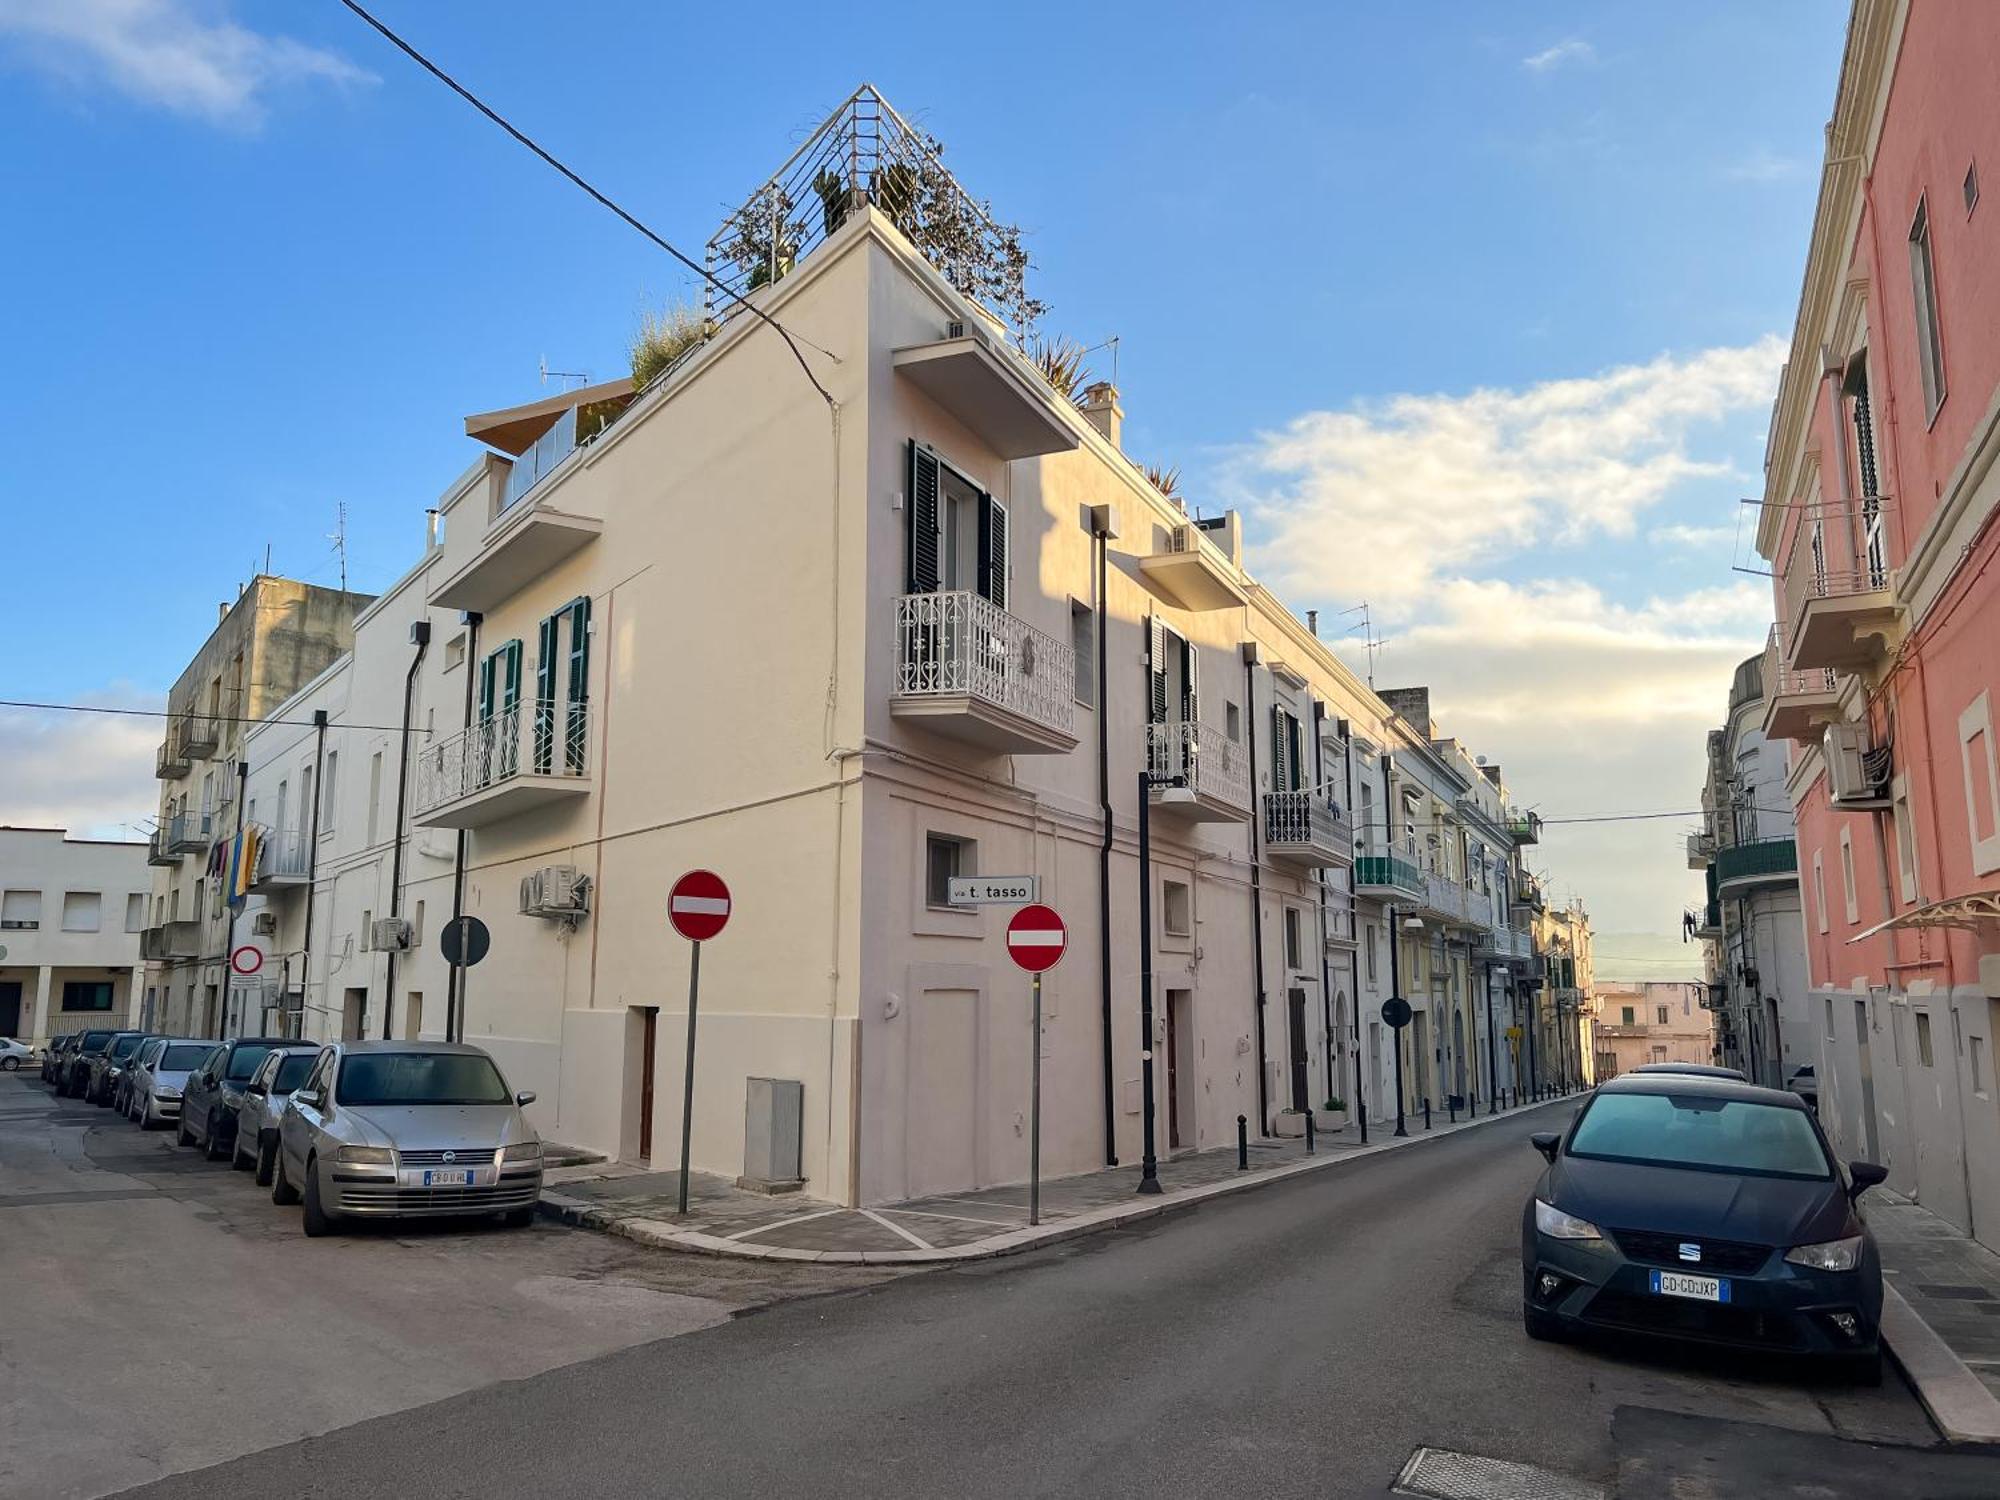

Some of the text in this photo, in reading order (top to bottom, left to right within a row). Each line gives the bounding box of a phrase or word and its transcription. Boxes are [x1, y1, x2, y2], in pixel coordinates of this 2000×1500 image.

[954, 886, 1027, 898] via t. tasso
